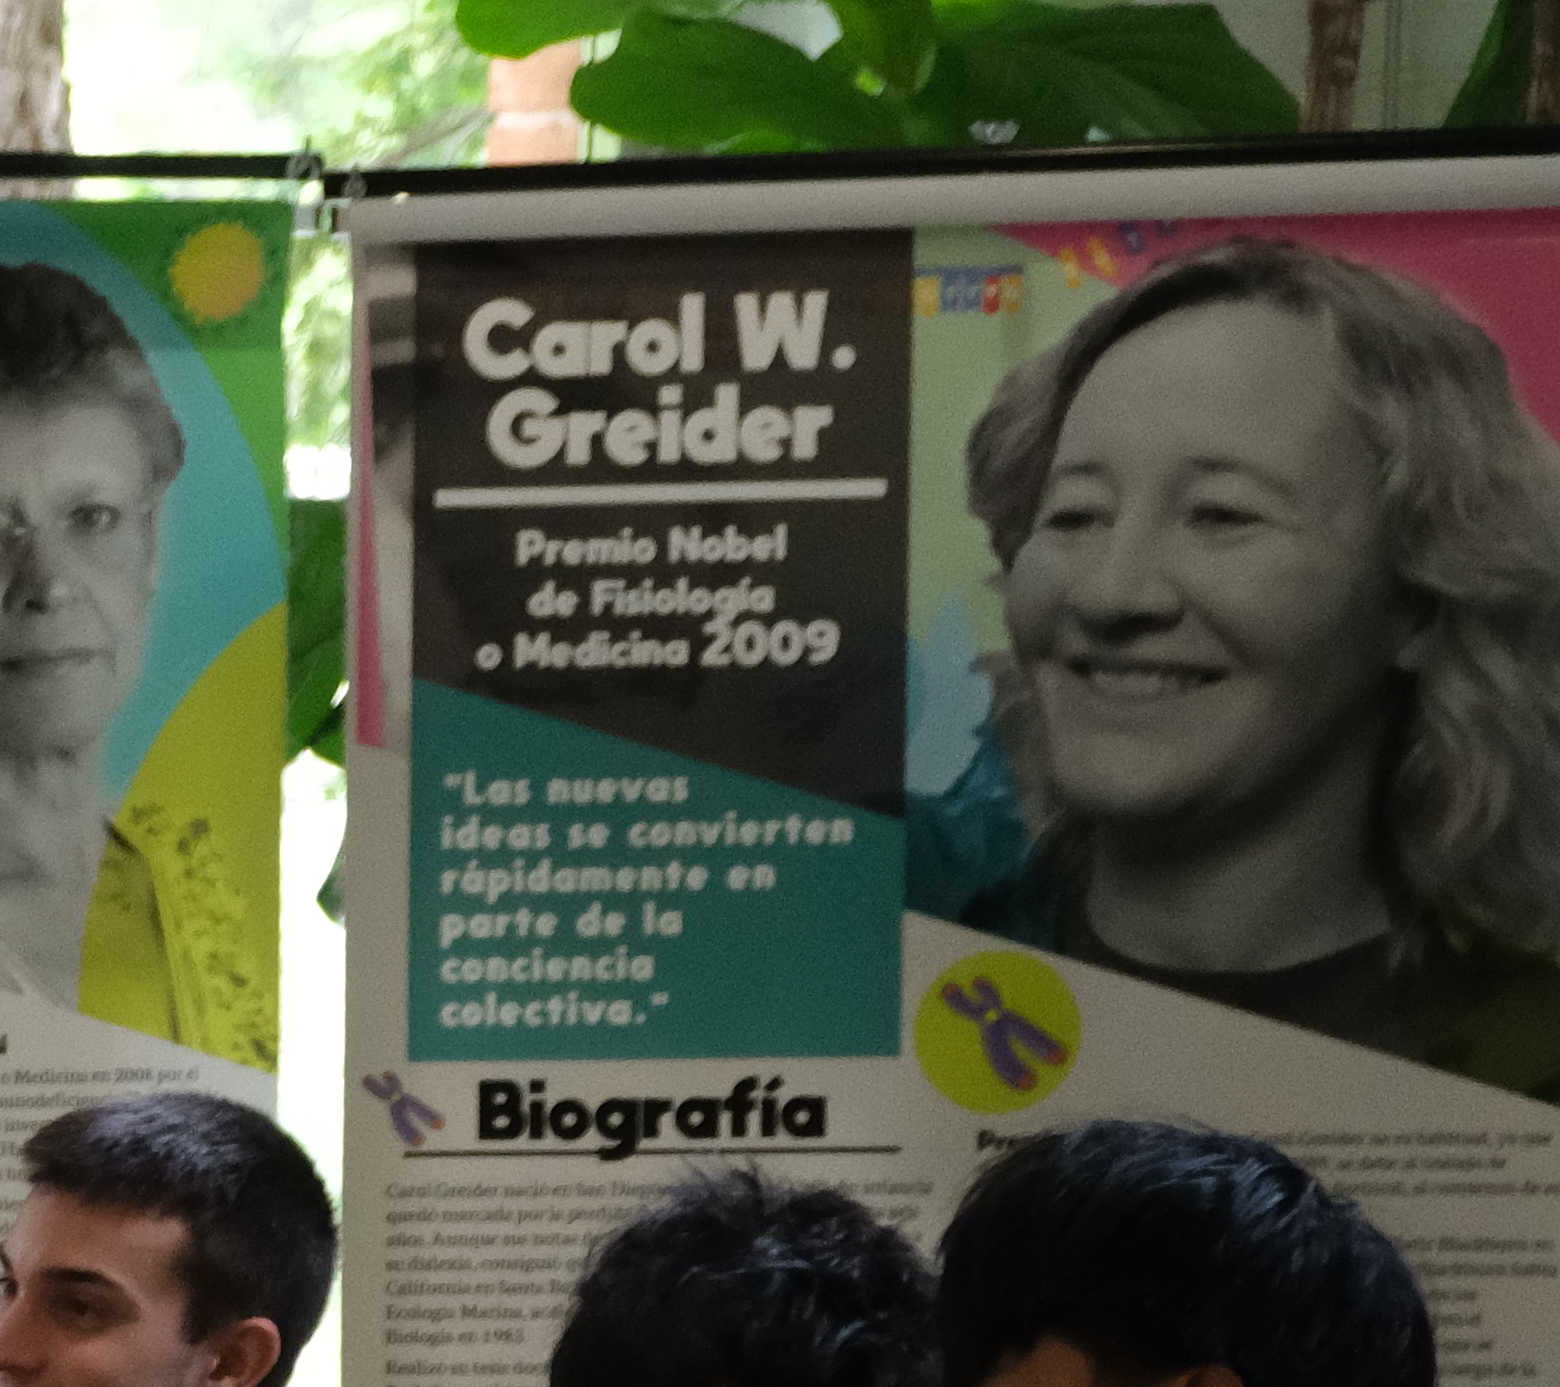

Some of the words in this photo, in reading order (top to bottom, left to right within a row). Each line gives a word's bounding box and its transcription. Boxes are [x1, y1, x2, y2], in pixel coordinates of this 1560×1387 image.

[463, 293, 705, 379] Carol
[735, 291, 855, 371] W.
[486, 382, 833, 469] Greider
[516, 527, 657, 566] Premio
[668, 523, 787, 563] Nobel
[527, 580, 579, 617] de
[590, 576, 779, 628] Fisiología
[475, 643, 502, 670] o
[513, 630, 690, 668] Medicina
[701, 614, 840, 666] 2009
[546, 776, 689, 805] nuevas
[441, 814, 551, 851] ideas
[568, 823, 610, 849] se
[627, 811, 854, 849] convierten
[440, 858, 708, 905] rápidamente
[726, 864, 776, 891] en
[439, 907, 558, 949] parte
[576, 902, 626, 938] de
[642, 900, 683, 936] la
[439, 946, 654, 984] conciencia
[477, 1079, 829, 1162] Biografía
